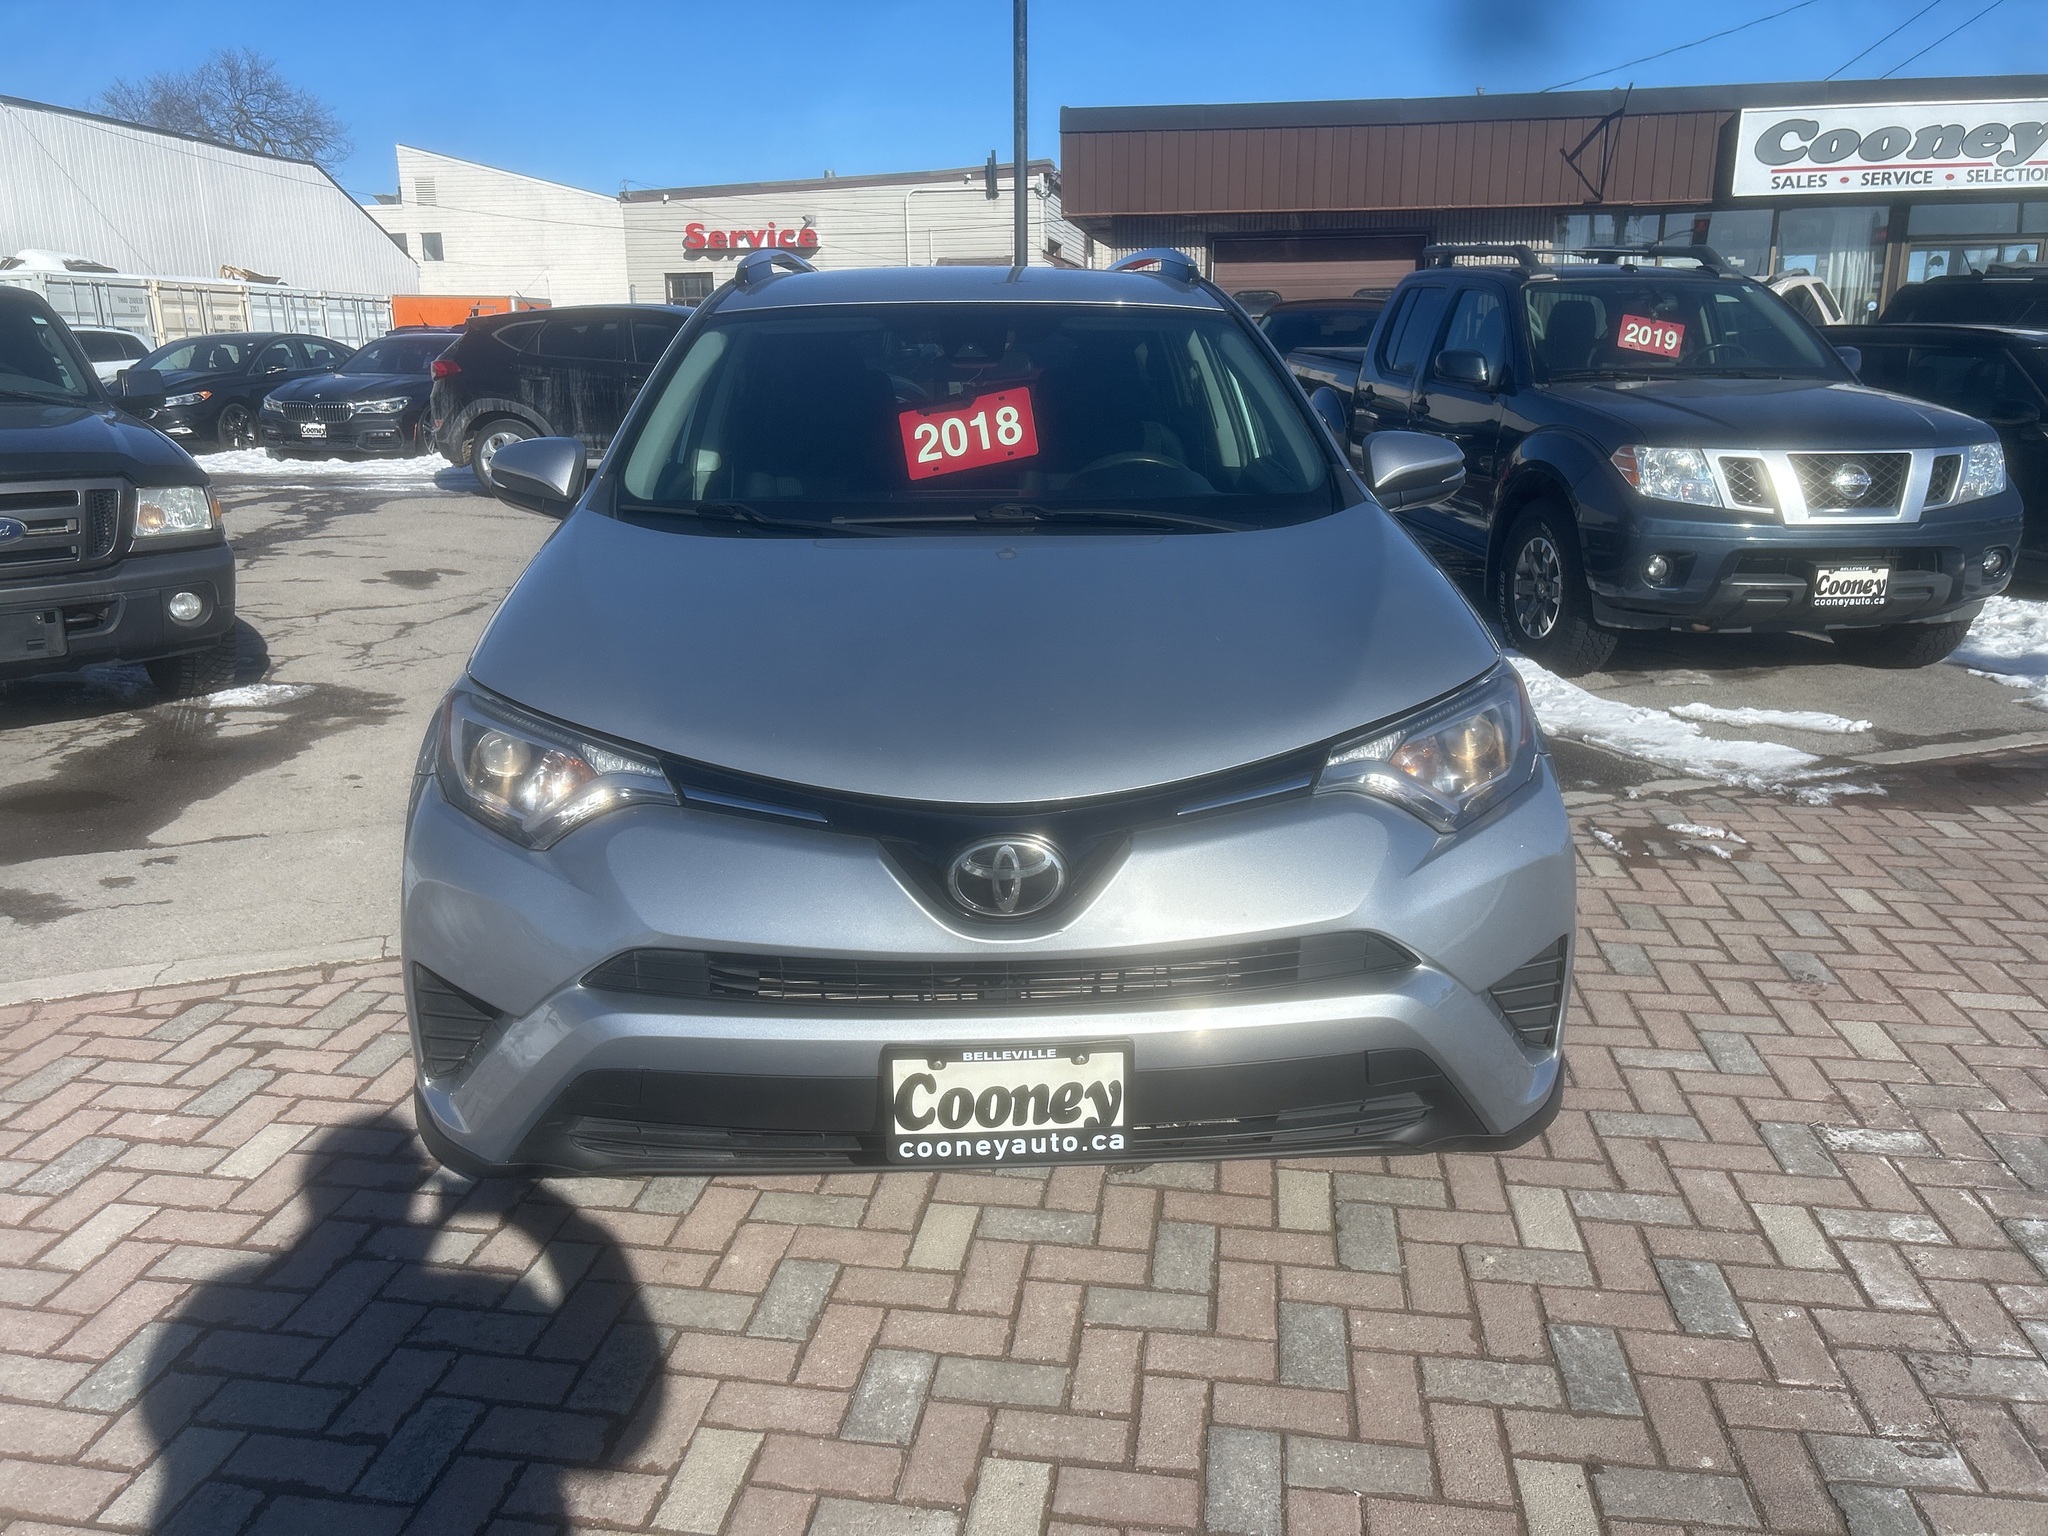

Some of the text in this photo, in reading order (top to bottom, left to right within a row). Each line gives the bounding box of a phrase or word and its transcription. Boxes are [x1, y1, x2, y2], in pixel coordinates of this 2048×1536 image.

[1755, 119, 2048, 167] Cooney
[1771, 174, 1828, 190] SALES
[1860, 171, 1933, 186] SERVICE
[684, 222, 818, 250] Service
[1624, 323, 1678, 350] 2019
[914, 406, 1023, 463] 2018
[1815, 575, 1887, 597] Cooney
[1814, 597, 1885, 607] cooneyauto.ca
[962, 1049, 1057, 1062] BELLEVILLE
[894, 1072, 1122, 1131] Cooney
[898, 1133, 1125, 1161] cooneyauto.ca
